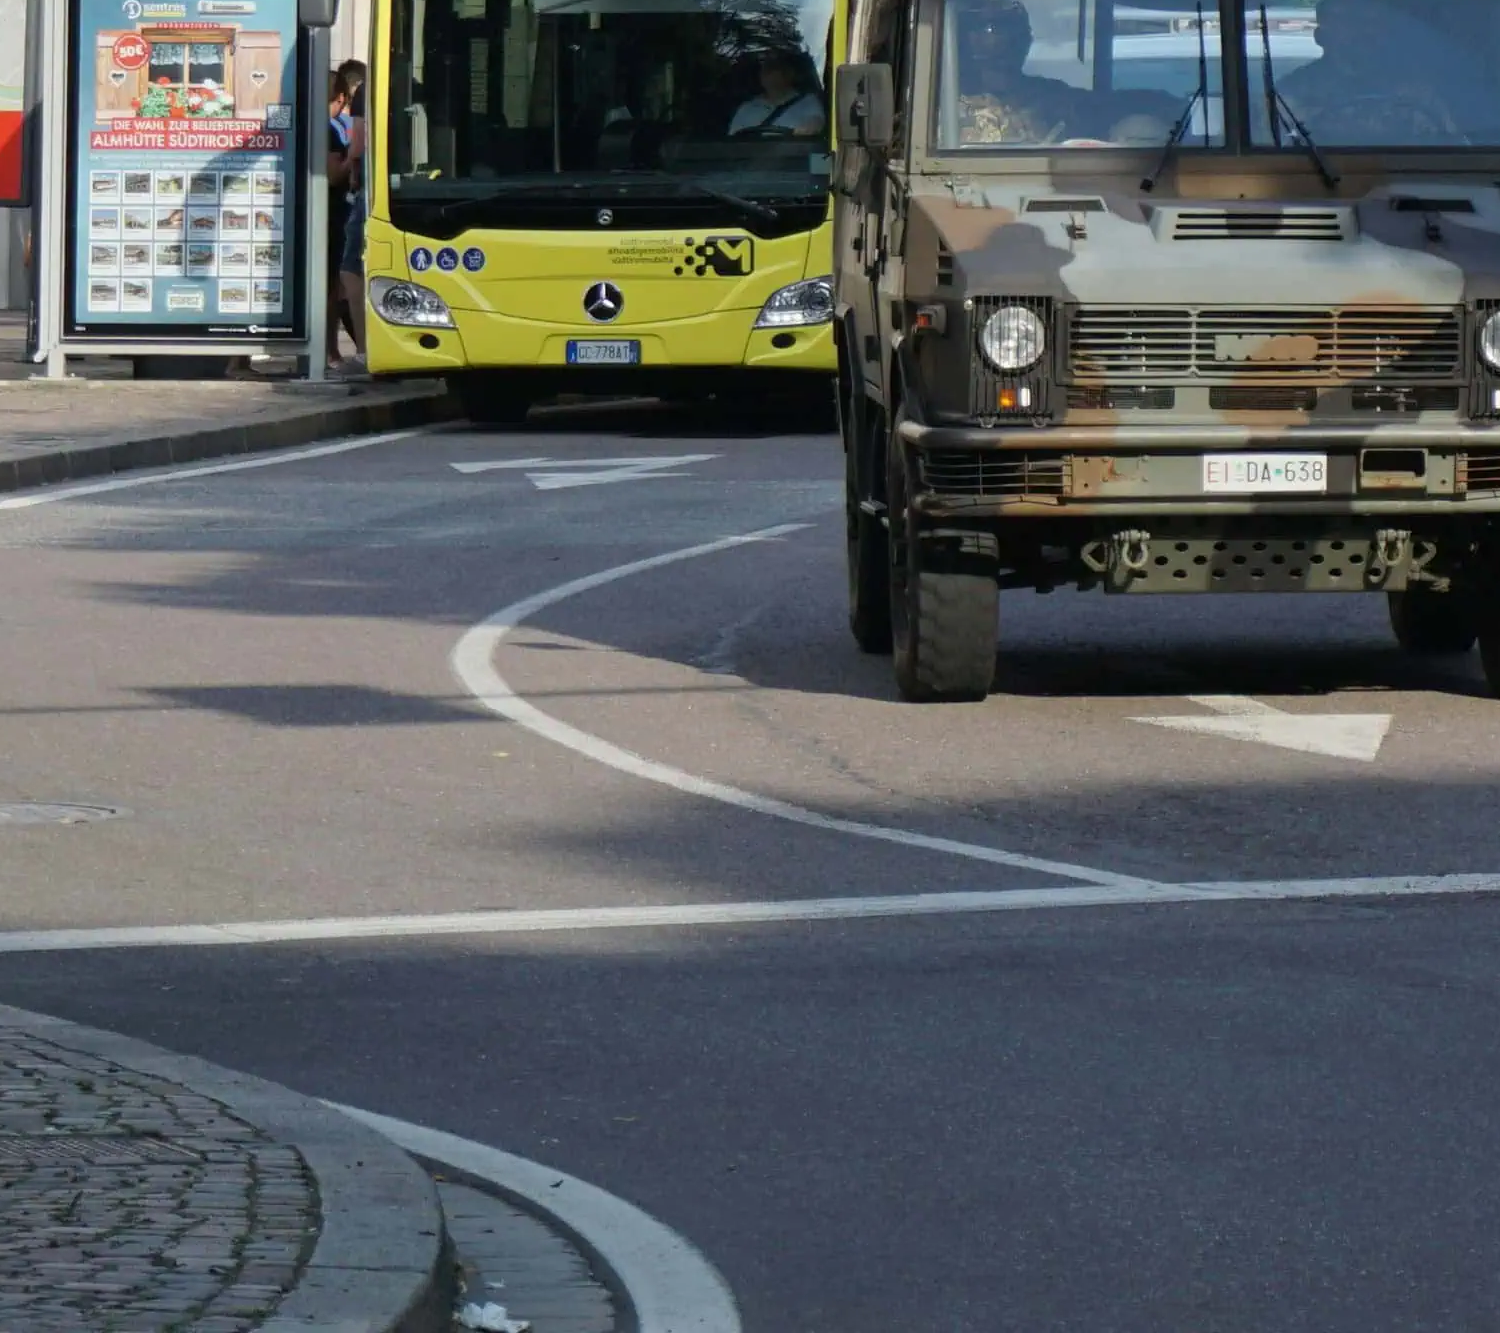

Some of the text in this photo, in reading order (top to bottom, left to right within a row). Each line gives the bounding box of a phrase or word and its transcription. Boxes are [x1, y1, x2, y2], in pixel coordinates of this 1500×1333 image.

[114, 119, 131, 131] DIE
[134, 119, 164, 131] WAHL
[168, 120, 190, 132] ZUR
[93, 131, 280, 148] ALMHÜTTE SÜDTIROLS 2021
[1207, 460, 1324, 483] EI DA 638
